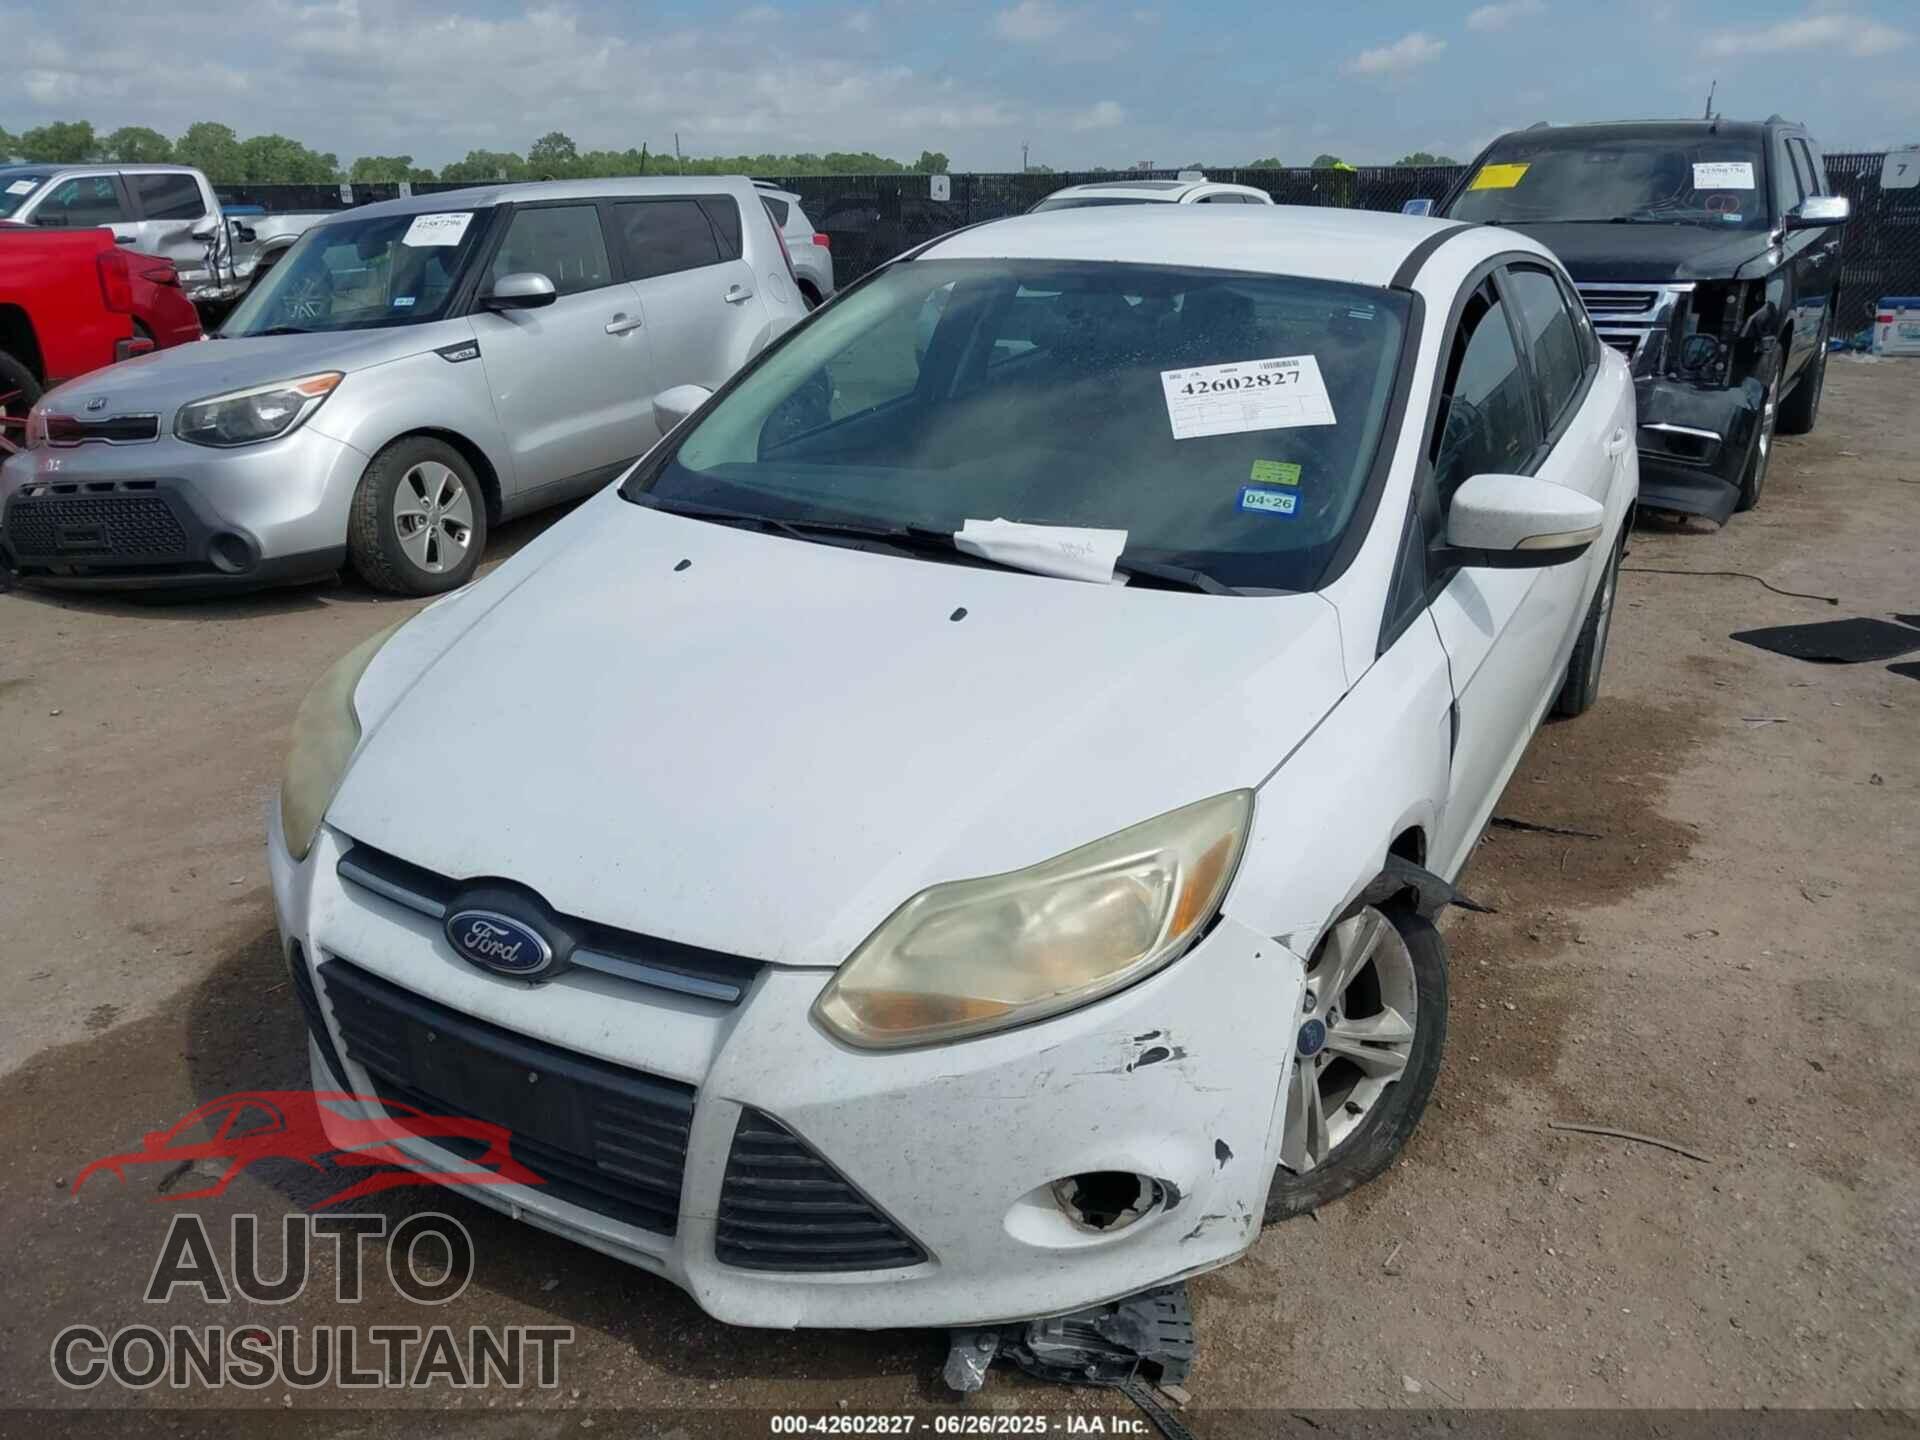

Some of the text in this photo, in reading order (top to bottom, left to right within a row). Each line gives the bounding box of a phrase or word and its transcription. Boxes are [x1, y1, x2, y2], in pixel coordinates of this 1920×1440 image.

[1897, 164, 1908, 177] 7
[1181, 370, 1301, 396] 42602827
[463, 920, 523, 962] Ford
